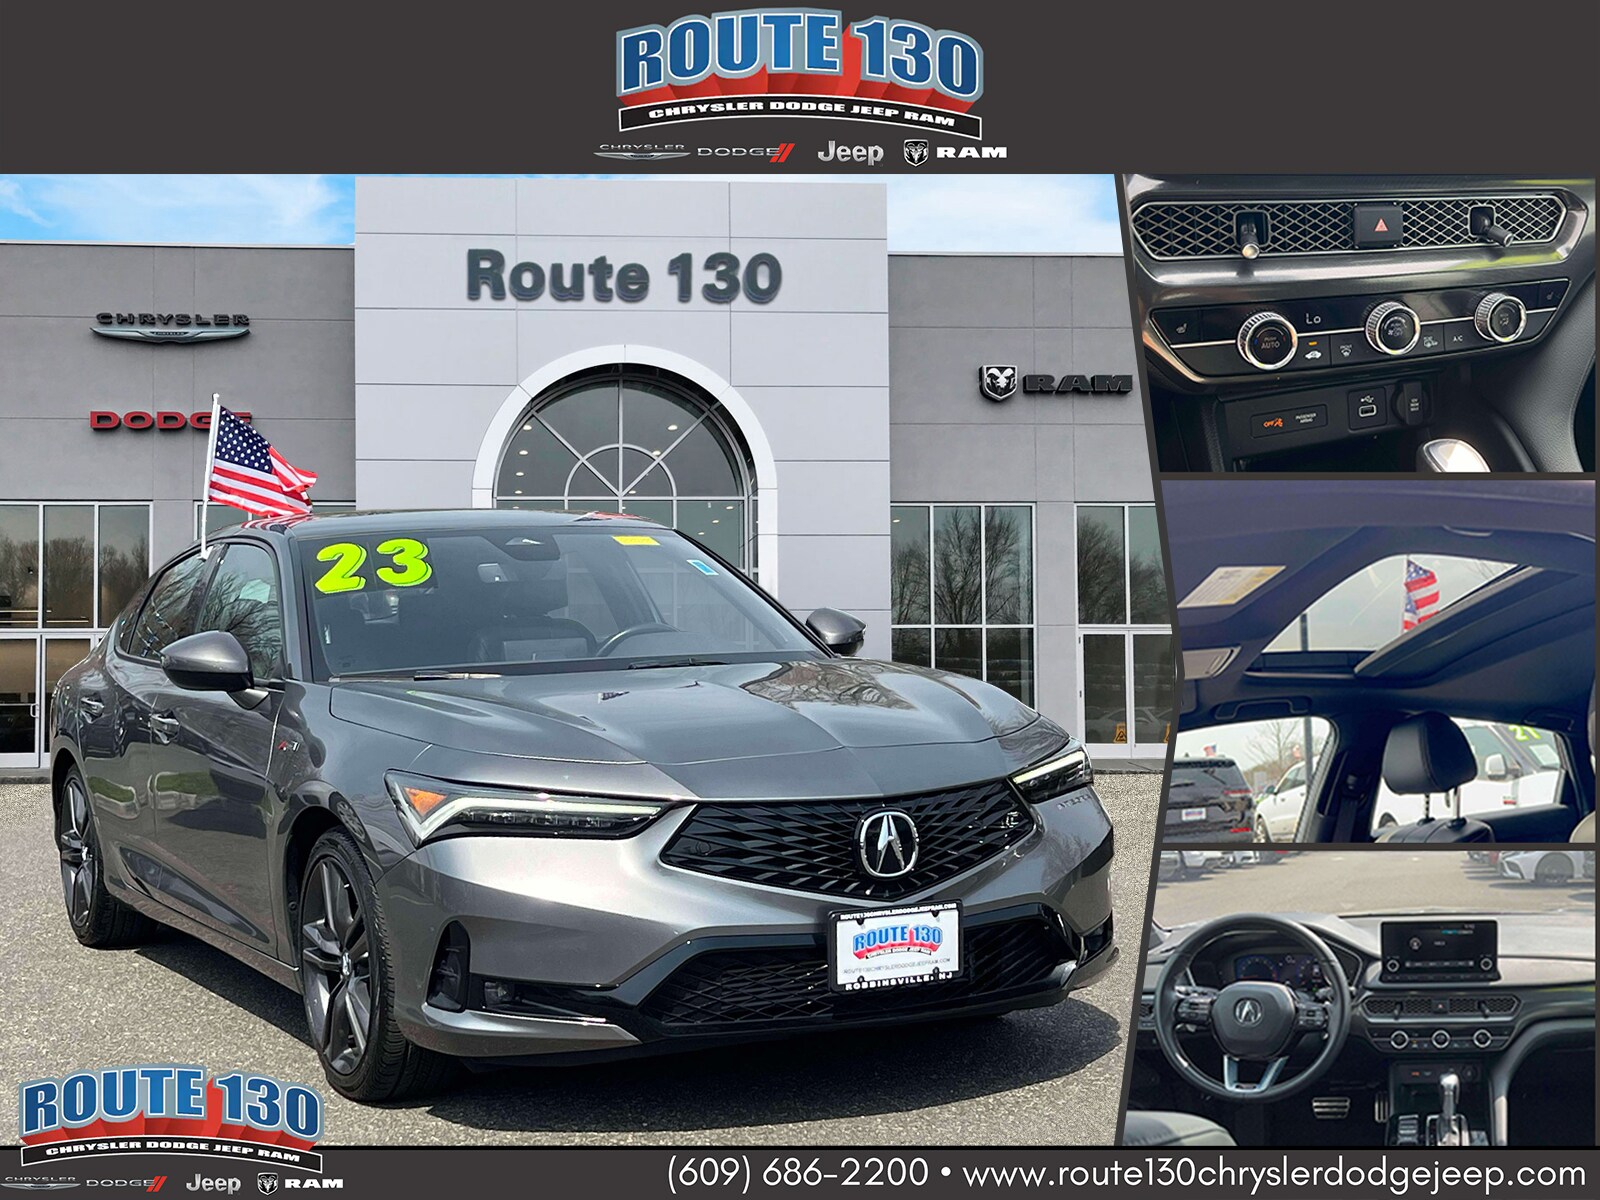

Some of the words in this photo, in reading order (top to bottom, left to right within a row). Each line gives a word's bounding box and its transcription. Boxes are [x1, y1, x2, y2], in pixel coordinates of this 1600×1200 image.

[466, 248, 650, 302] Route
[668, 251, 782, 305] 130
[96, 312, 250, 326] CHRYSLER
[1260, 341, 1281, 350] AUTO
[1023, 374, 1133, 394] RAM
[314, 538, 433, 594] 23
[853, 925, 909, 951] ROUTE
[911, 925, 944, 945] 130
[938, 972, 953, 980] NJ
